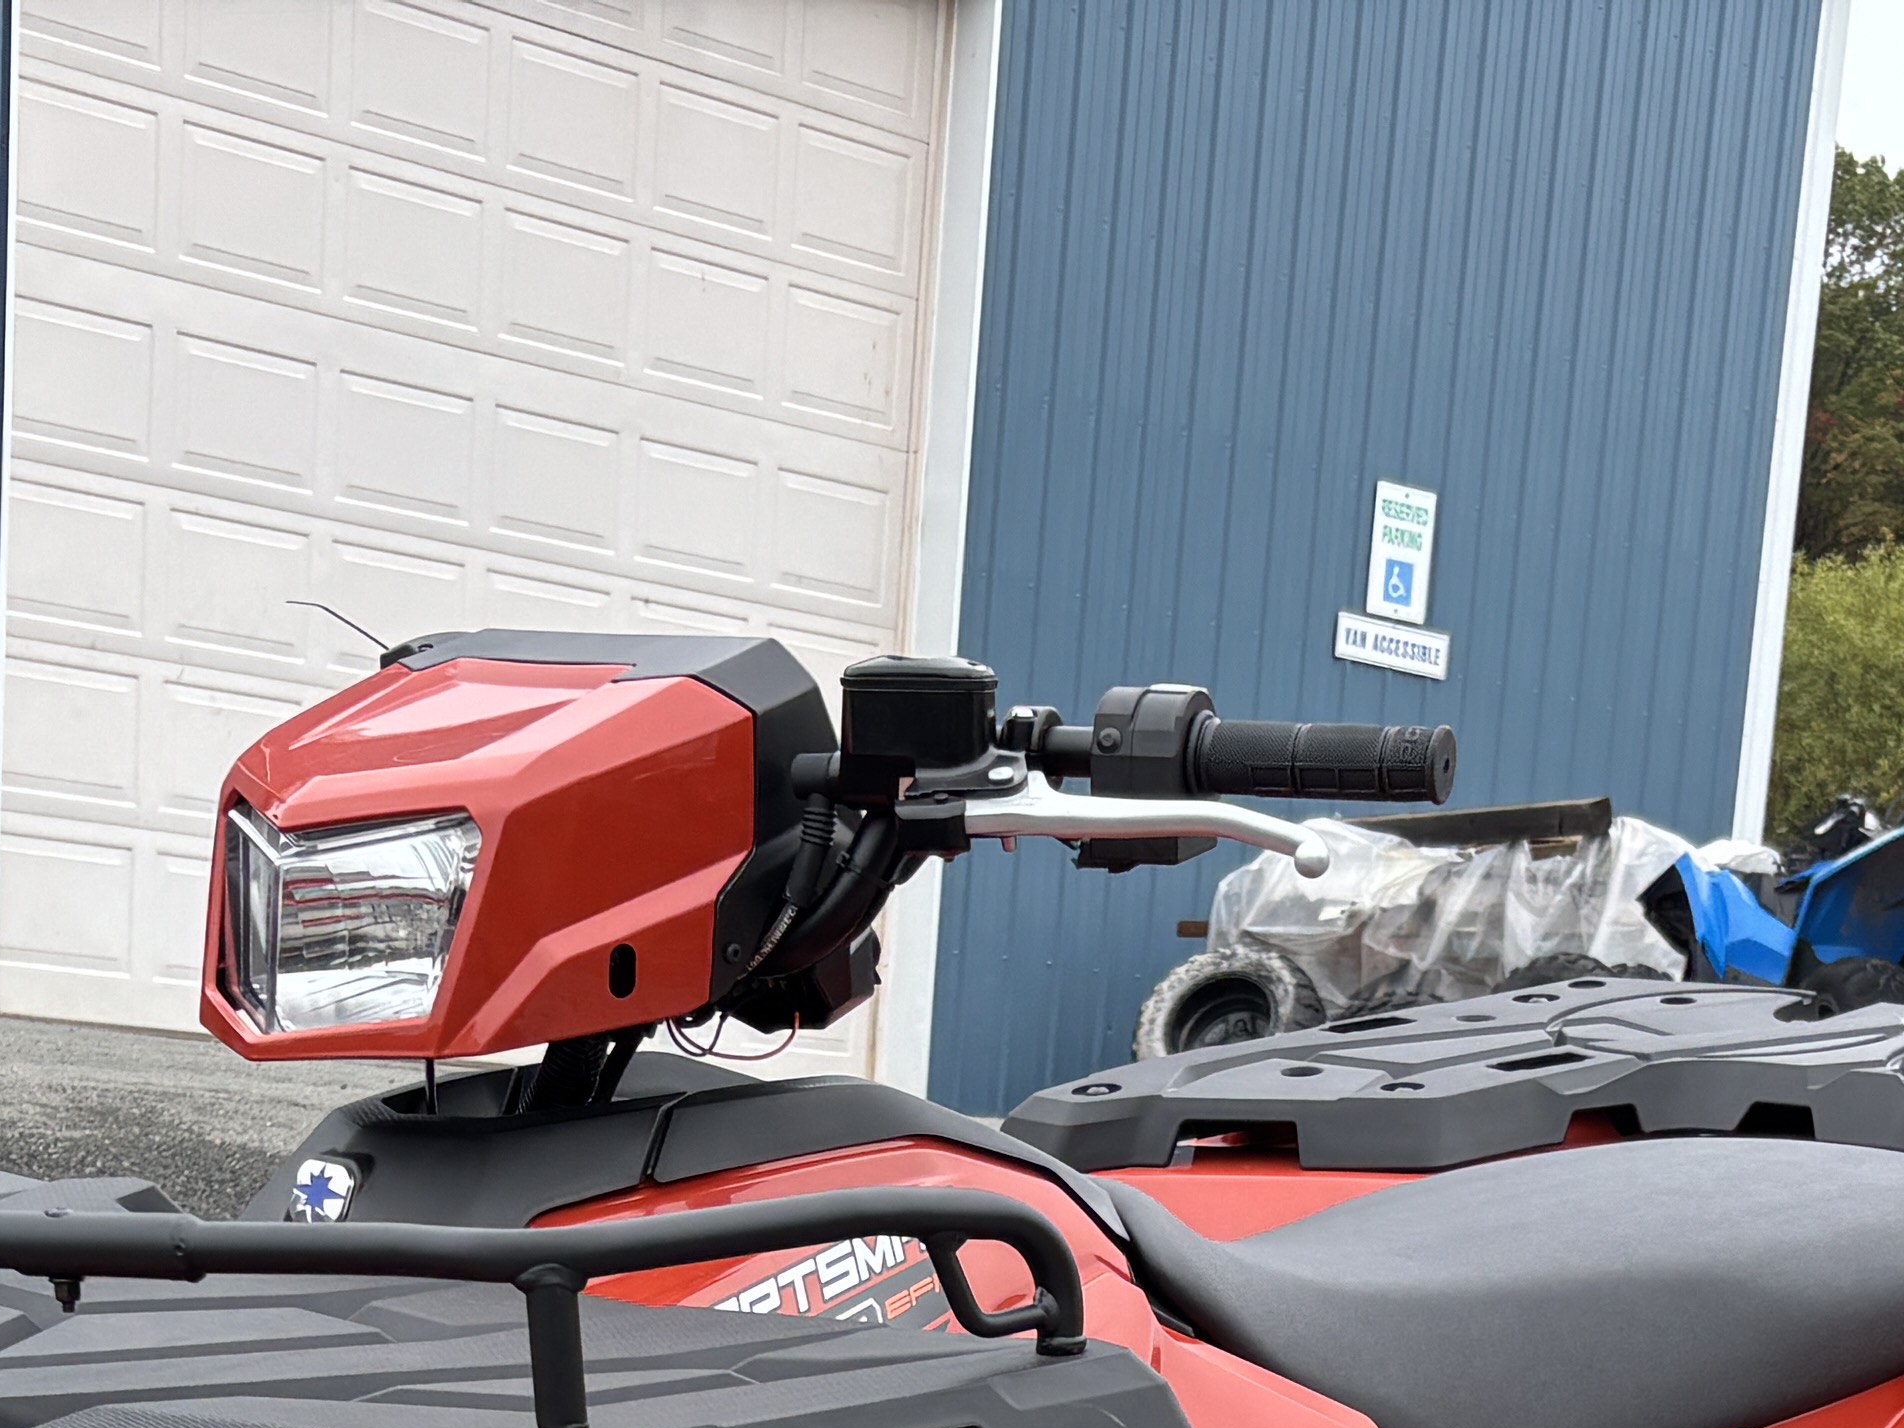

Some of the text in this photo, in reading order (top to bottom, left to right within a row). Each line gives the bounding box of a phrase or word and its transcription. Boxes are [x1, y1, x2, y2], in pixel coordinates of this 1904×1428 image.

[1381, 525, 1423, 551] PARKING
[1345, 628, 1441, 666] VAN ACCESSIBLE
